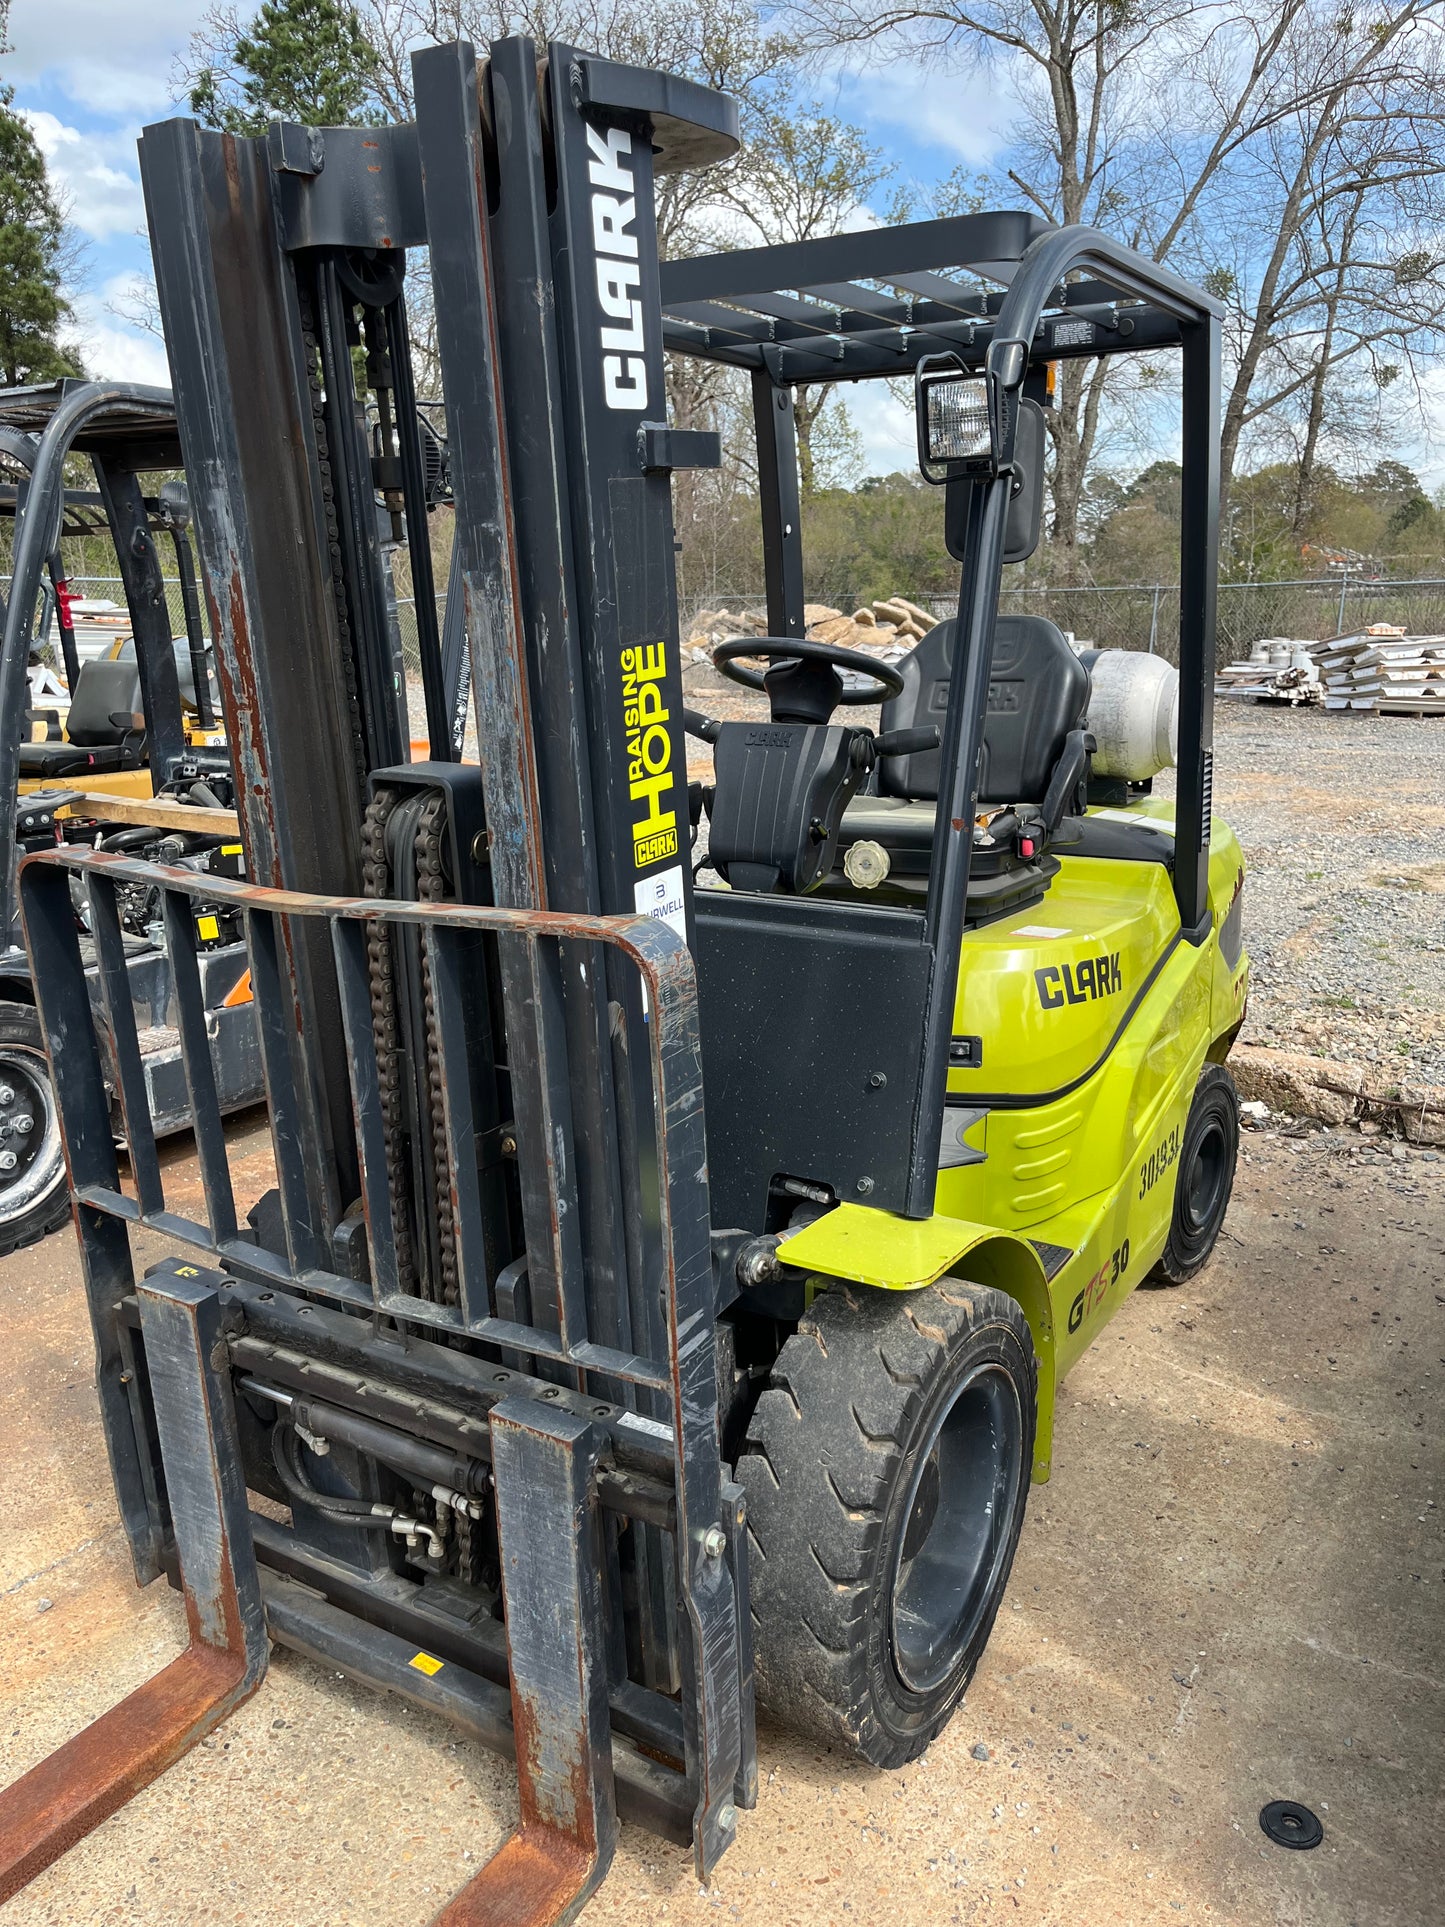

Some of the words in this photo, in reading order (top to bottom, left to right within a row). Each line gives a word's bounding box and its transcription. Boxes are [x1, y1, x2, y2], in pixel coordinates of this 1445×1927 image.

[586, 122, 648, 410] CLARK
[621, 648, 644, 781] RAISING
[630, 642, 677, 841] HOPE
[637, 832, 675, 863] CLARK
[646, 898, 684, 919] RWELL
[1034, 952, 1122, 1010] CLARK
